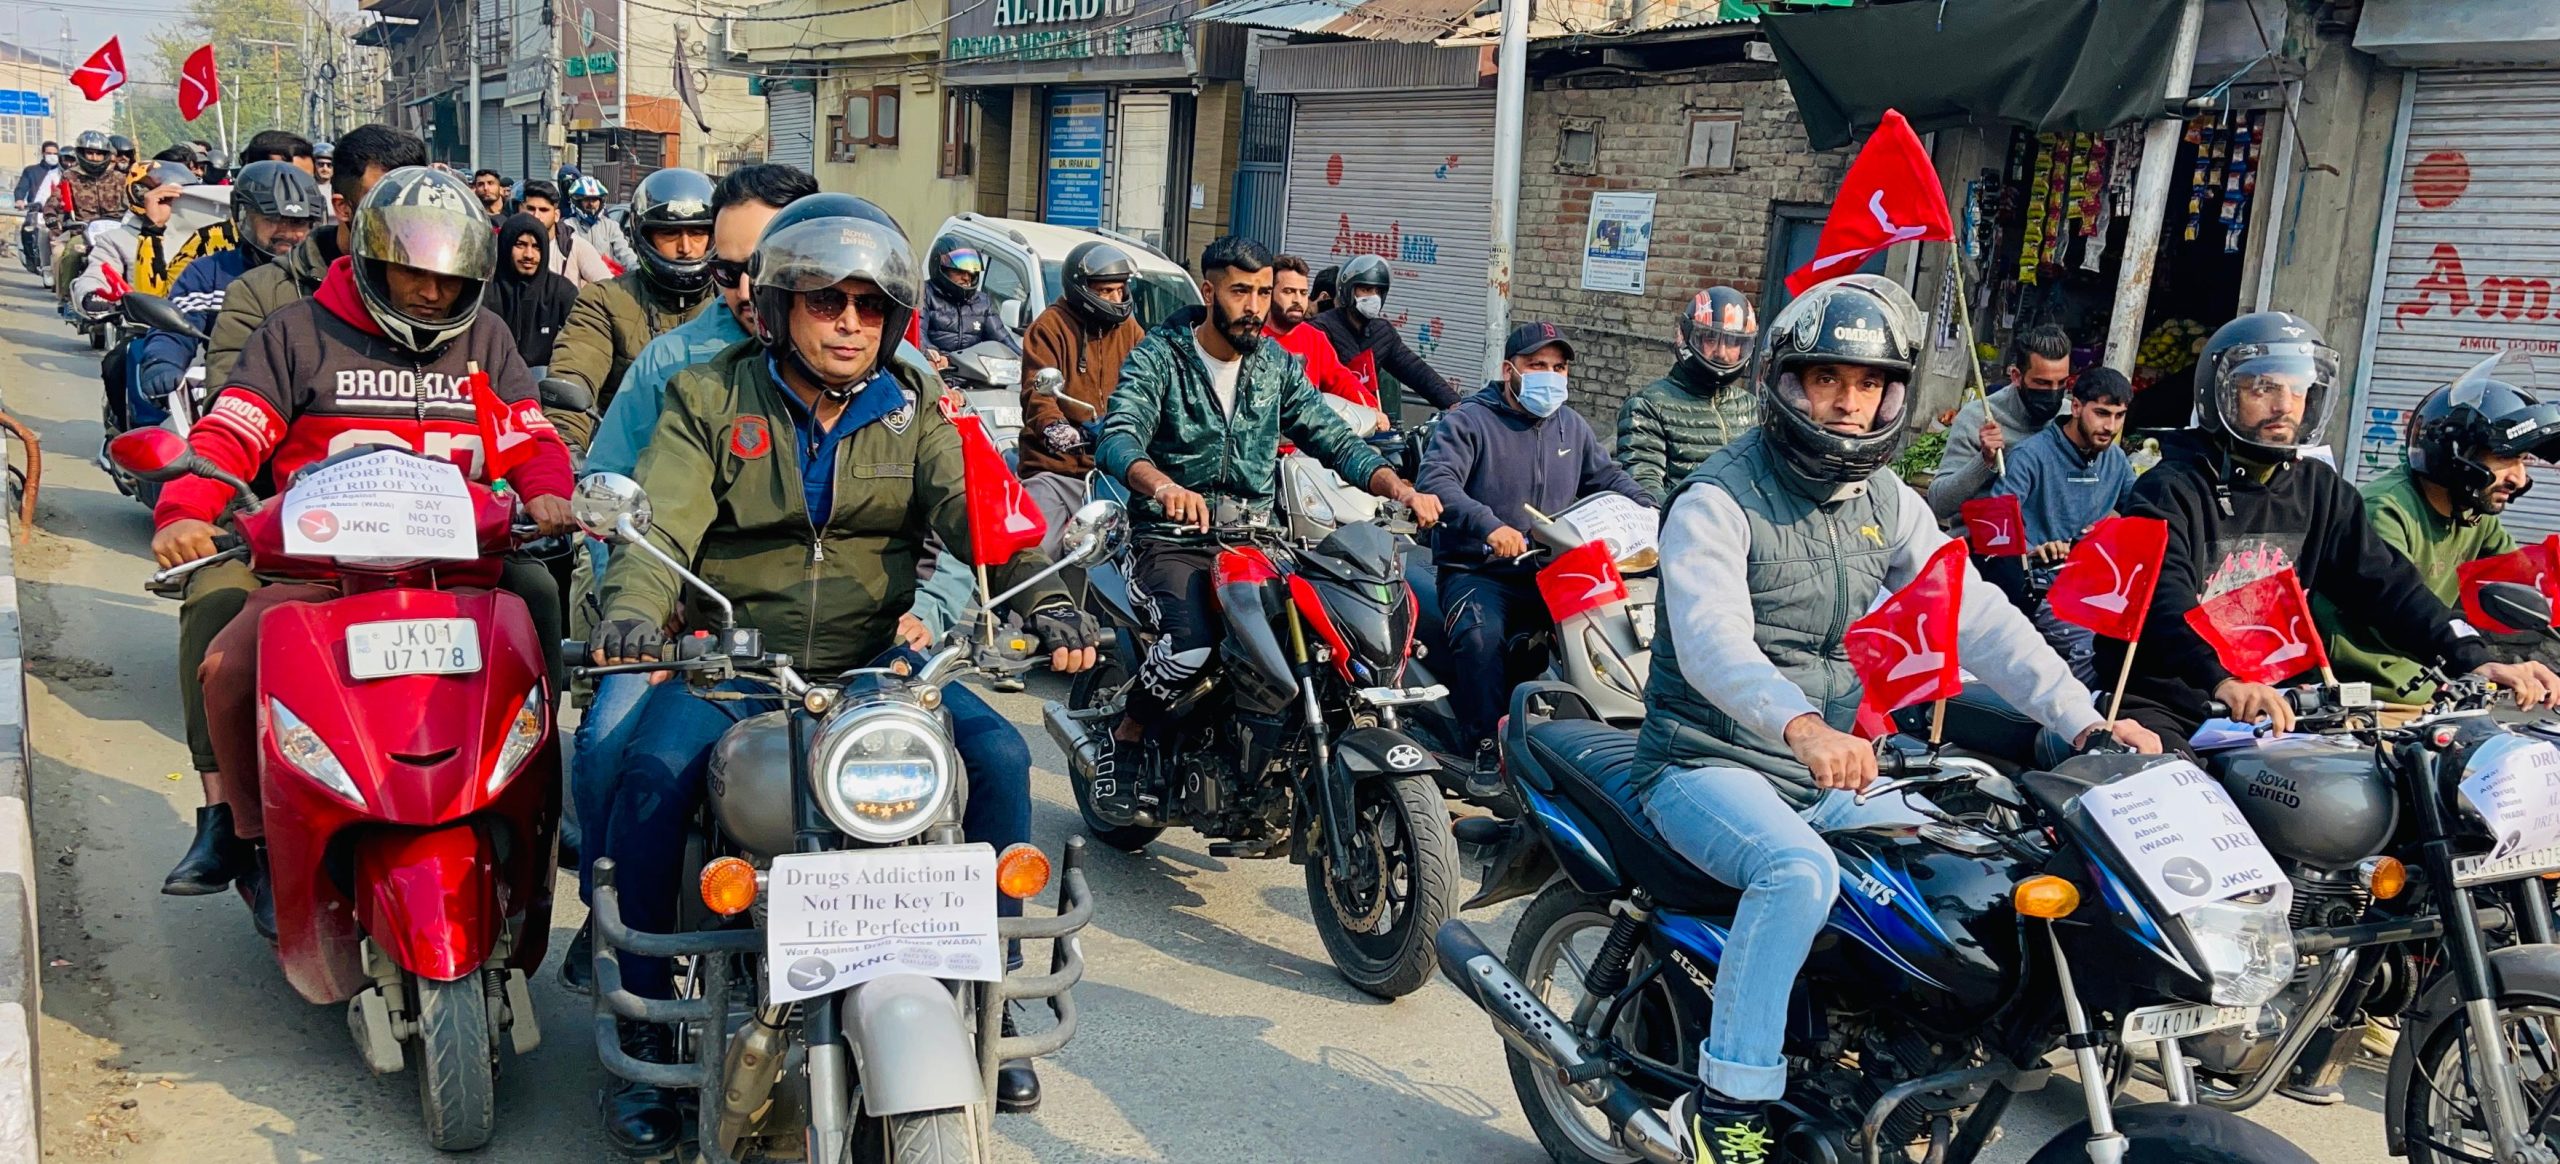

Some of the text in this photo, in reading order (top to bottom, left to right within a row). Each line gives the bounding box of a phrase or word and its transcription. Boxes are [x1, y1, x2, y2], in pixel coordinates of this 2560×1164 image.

[1330, 212, 1399, 260] Amul
[2396, 242, 2560, 331] Am
[1834, 326, 1887, 344] OMEGA
[2459, 336, 2501, 350] AMUL
[347, 481, 378, 490] RID
[382, 480, 405, 490] OF
[415, 499, 443, 511] SAY
[342, 521, 390, 533] JKNC
[408, 512, 452, 524] NO TO
[406, 525, 456, 539] DRUGS
[1625, 538, 1646, 553] JKNC
[392, 623, 452, 647] JK01
[384, 647, 465, 671] U7178
[2255, 769, 2297, 792] ROYAL
[2111, 790, 2135, 801] War
[2247, 783, 2300, 809] ENFIELD
[2492, 787, 2516, 798] Drug
[2111, 797, 2155, 817] Against
[2127, 811, 2158, 826] Drug
[2134, 821, 2171, 840] Abuse
[2139, 832, 2184, 855] (WADA)
[786, 865, 980, 889] Drugs Addiction Is
[2220, 868, 2263, 889] JKNC
[1857, 872, 1898, 906] TVS
[802, 891, 965, 913] Not The Key To
[807, 918, 960, 938] Life Perfection
[785, 948, 809, 956] War
[813, 945, 860, 956] Against
[937, 938, 982, 947] (WADA)
[839, 953, 896, 974] JKNC
